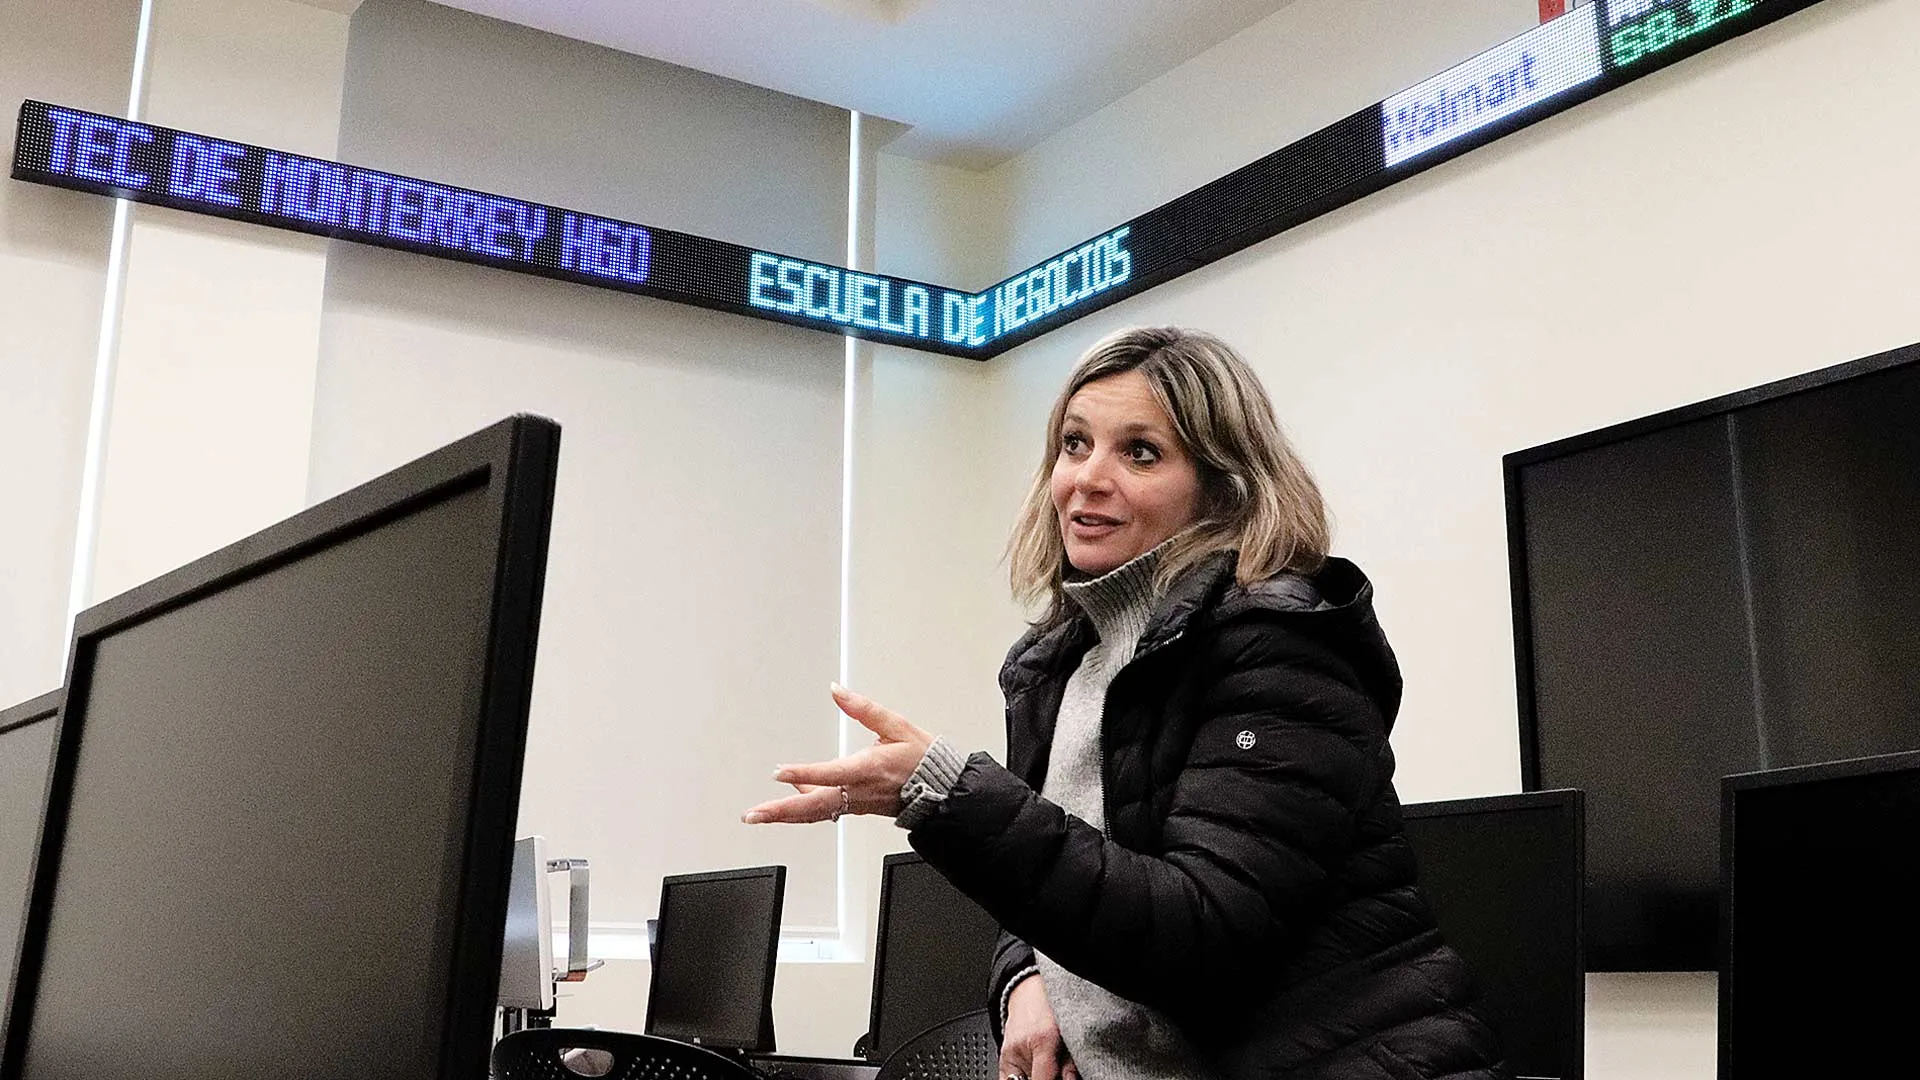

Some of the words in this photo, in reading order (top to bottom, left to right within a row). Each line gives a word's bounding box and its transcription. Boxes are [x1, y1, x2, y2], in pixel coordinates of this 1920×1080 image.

[1381, 50, 1537, 150] Walmart
[46, 108, 154, 189] TEC
[167, 133, 246, 206] DE
[261, 150, 548, 262] MONTERREY
[560, 212, 651, 284] HGO
[749, 250, 929, 338] ESCUELA
[943, 290, 987, 346] DE
[994, 226, 1132, 336] NEGOCIOS
